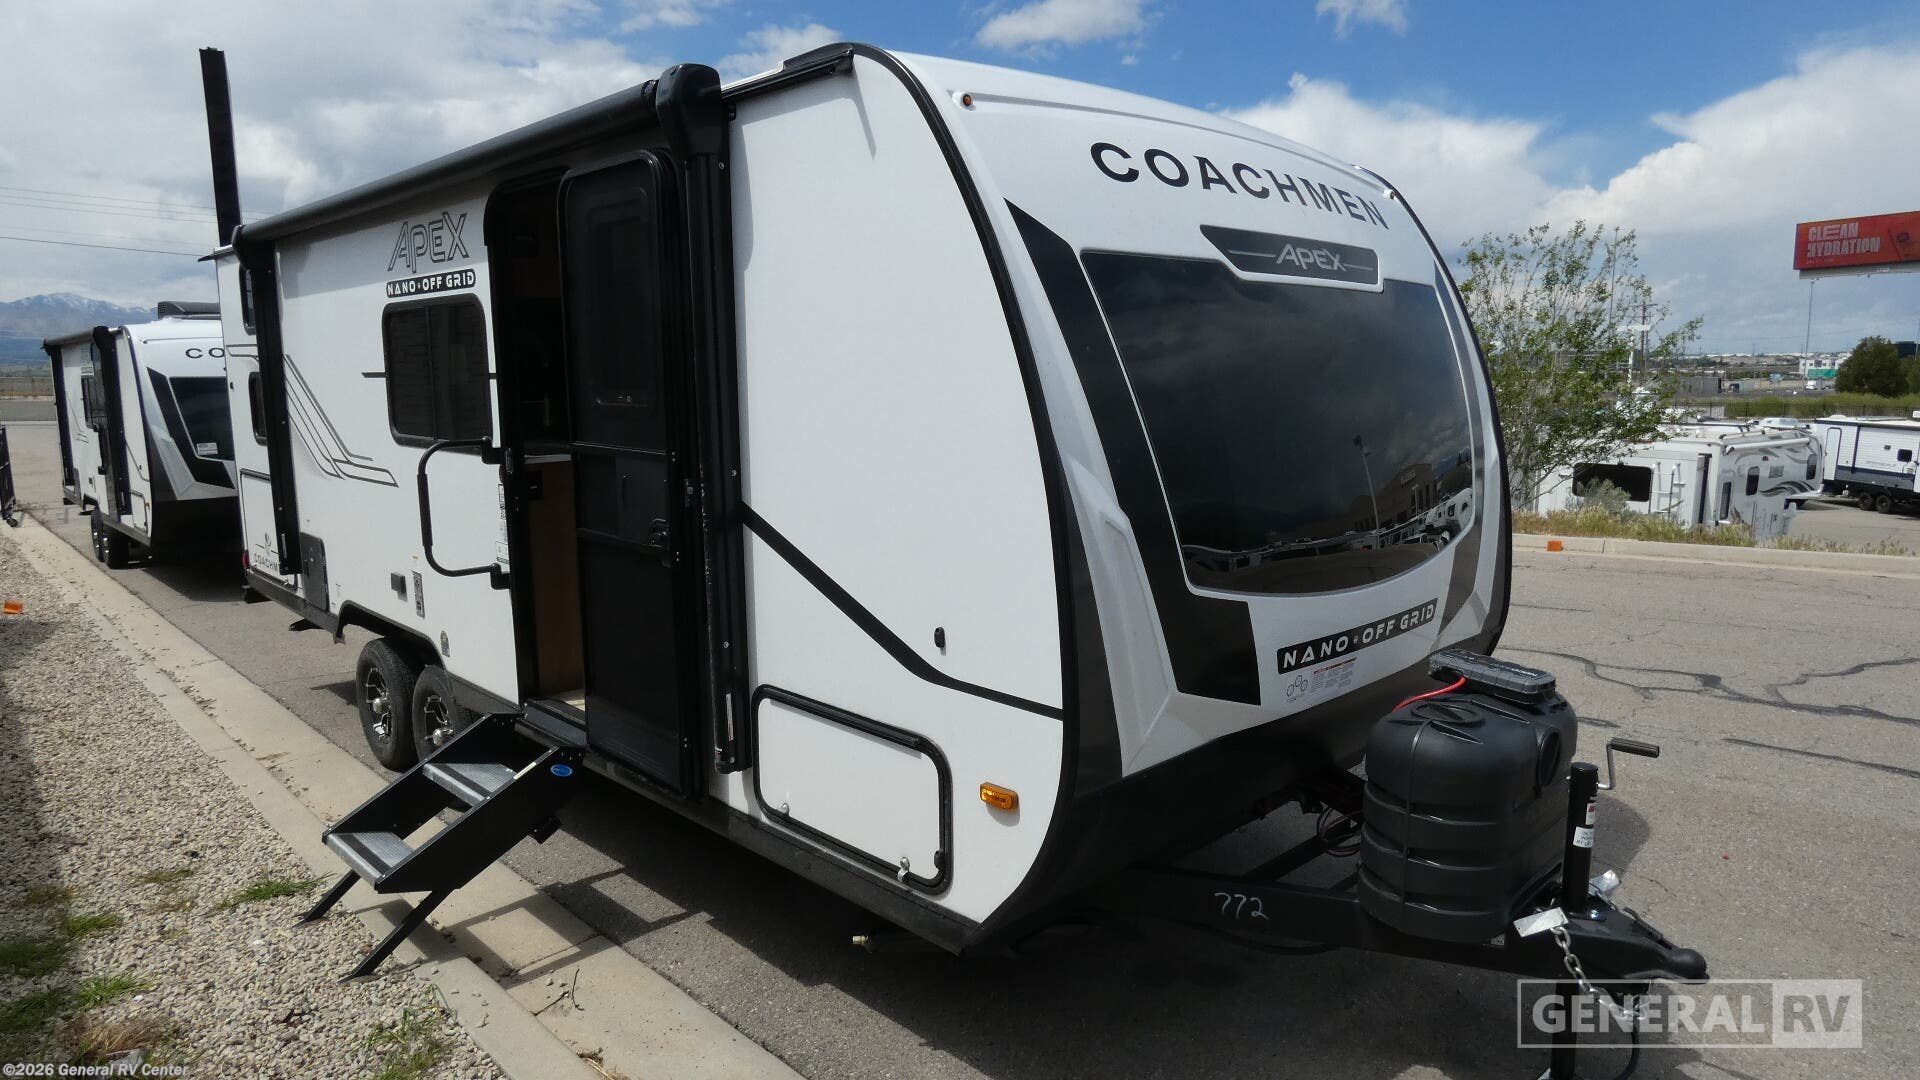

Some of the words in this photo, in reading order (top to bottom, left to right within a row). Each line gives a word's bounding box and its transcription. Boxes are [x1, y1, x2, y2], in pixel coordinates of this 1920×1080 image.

[1090, 142, 1390, 230] COACHMEN
[387, 211, 470, 273] APEX
[1806, 237, 1881, 258] HYDRATION
[387, 281, 416, 296] NANO
[422, 275, 443, 291] OFF
[446, 271, 475, 288] GRID
[1283, 635, 1350, 669] NANO
[1362, 618, 1396, 644] OFF
[1400, 603, 1435, 629] GRID
[1214, 892, 1270, 921] 772
